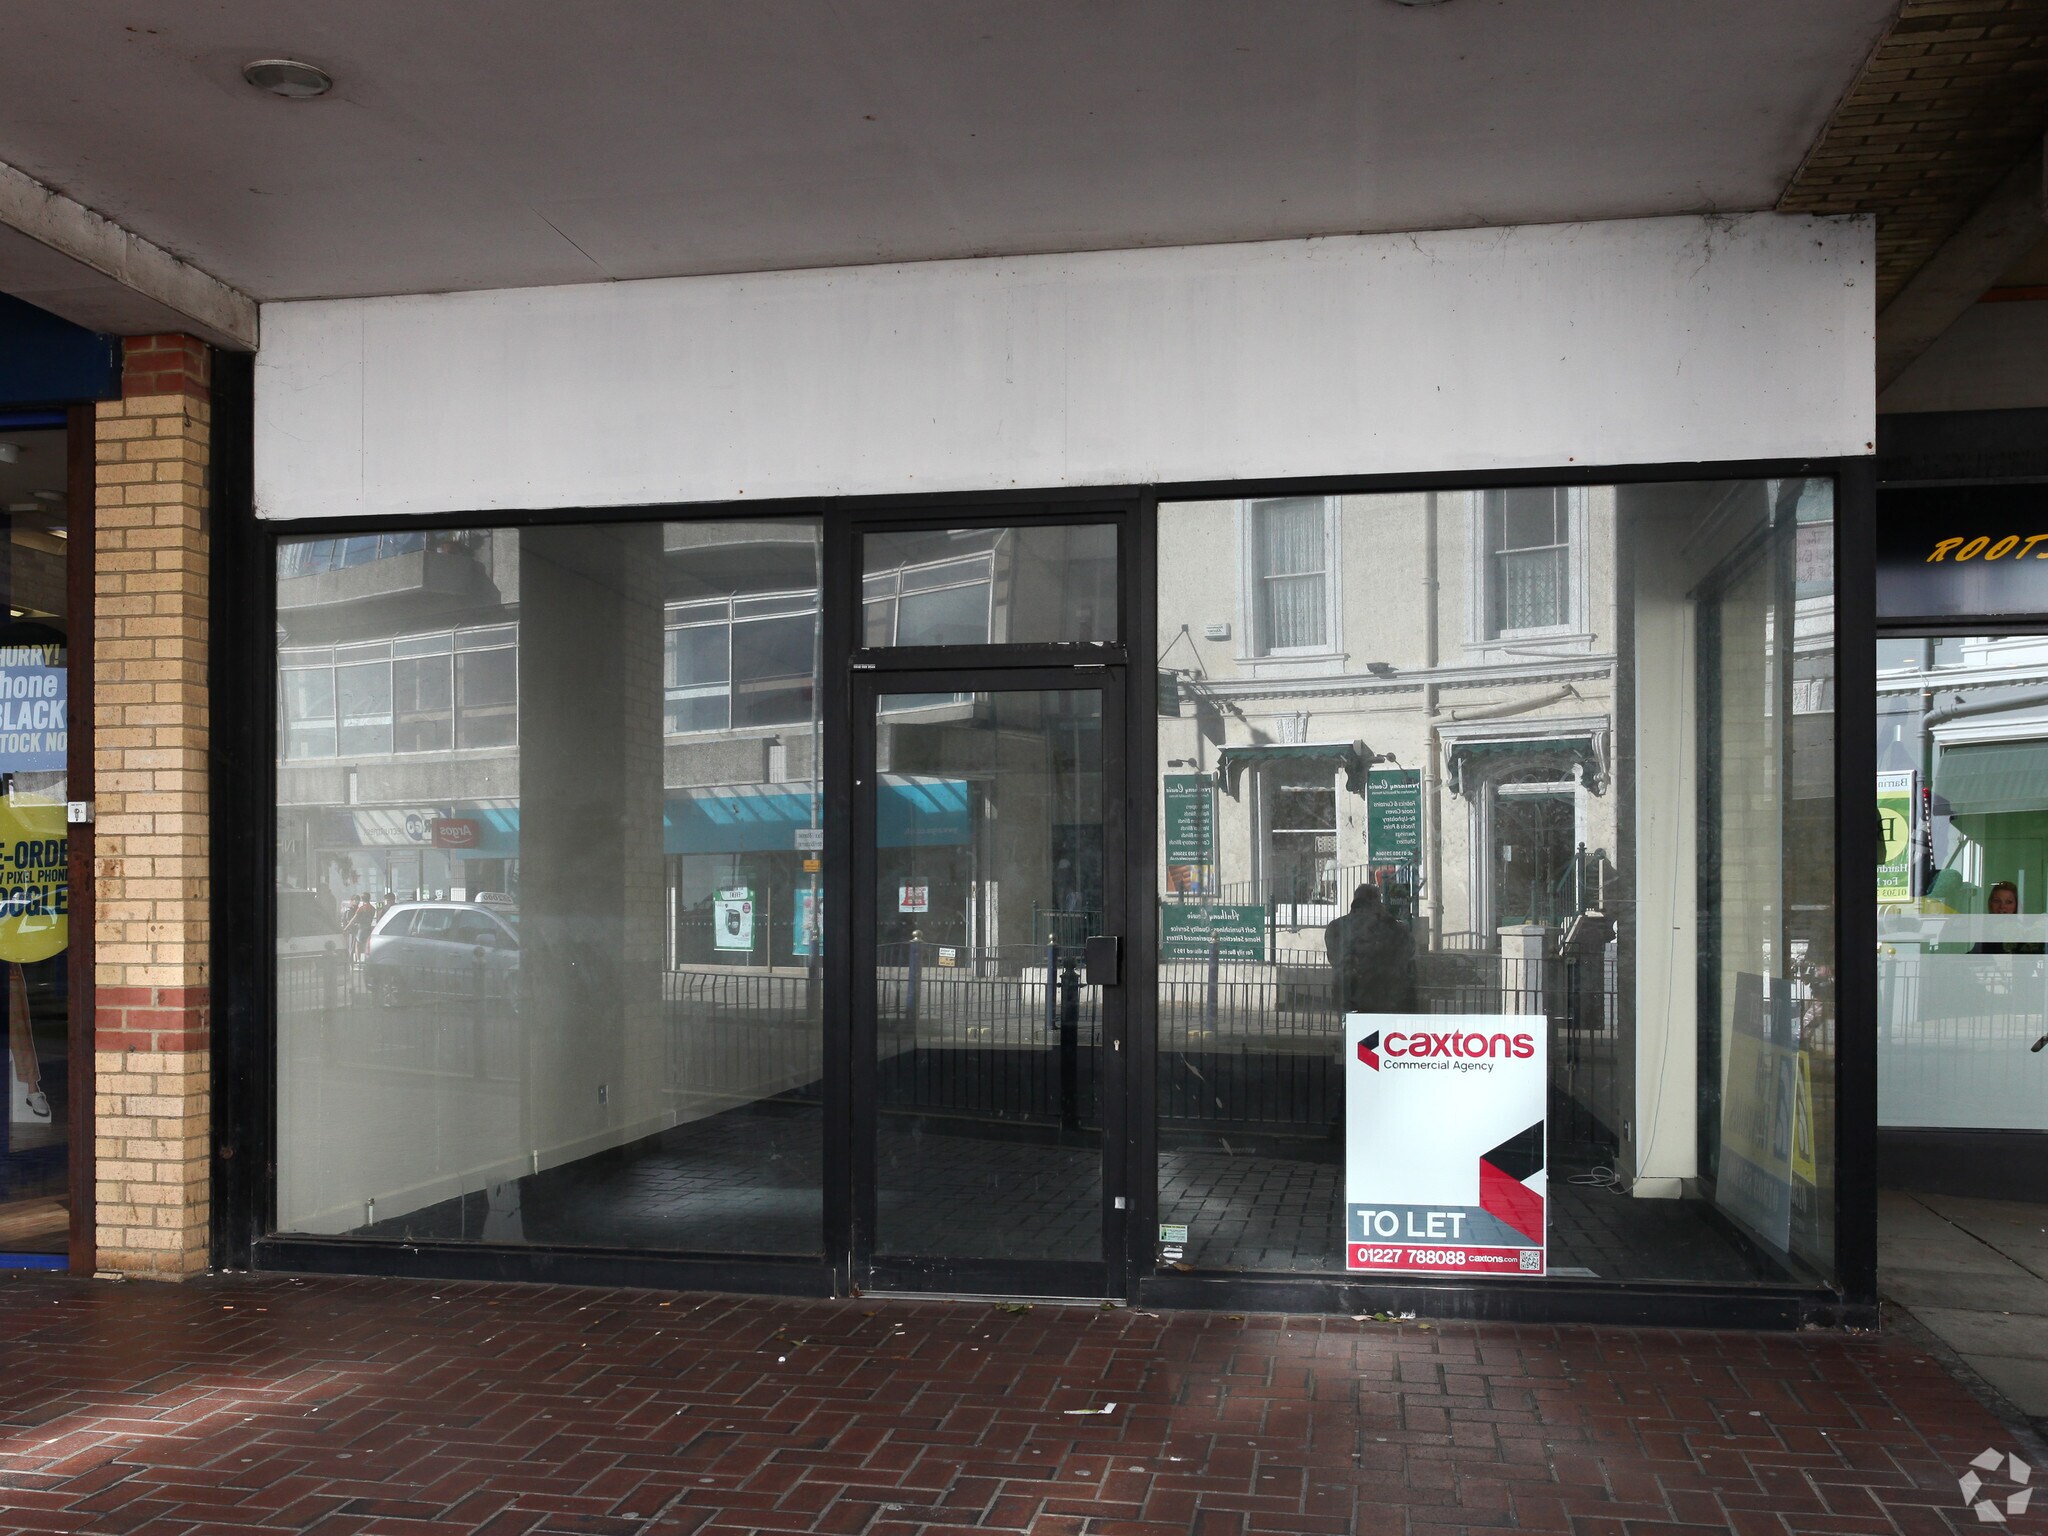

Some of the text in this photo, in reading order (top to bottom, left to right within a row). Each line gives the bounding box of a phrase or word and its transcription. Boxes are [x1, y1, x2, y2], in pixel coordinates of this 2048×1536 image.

[0, 700, 66, 730] LACK
[7, 870, 34, 884] PIXEL
[1384, 1029, 1535, 1058] caxtons
[1384, 1060, 1494, 1073] Commercial Agency
[1357, 1210, 1466, 1238] TO LET
[1357, 1248, 1518, 1265] 01227 788088 caxtons.com
